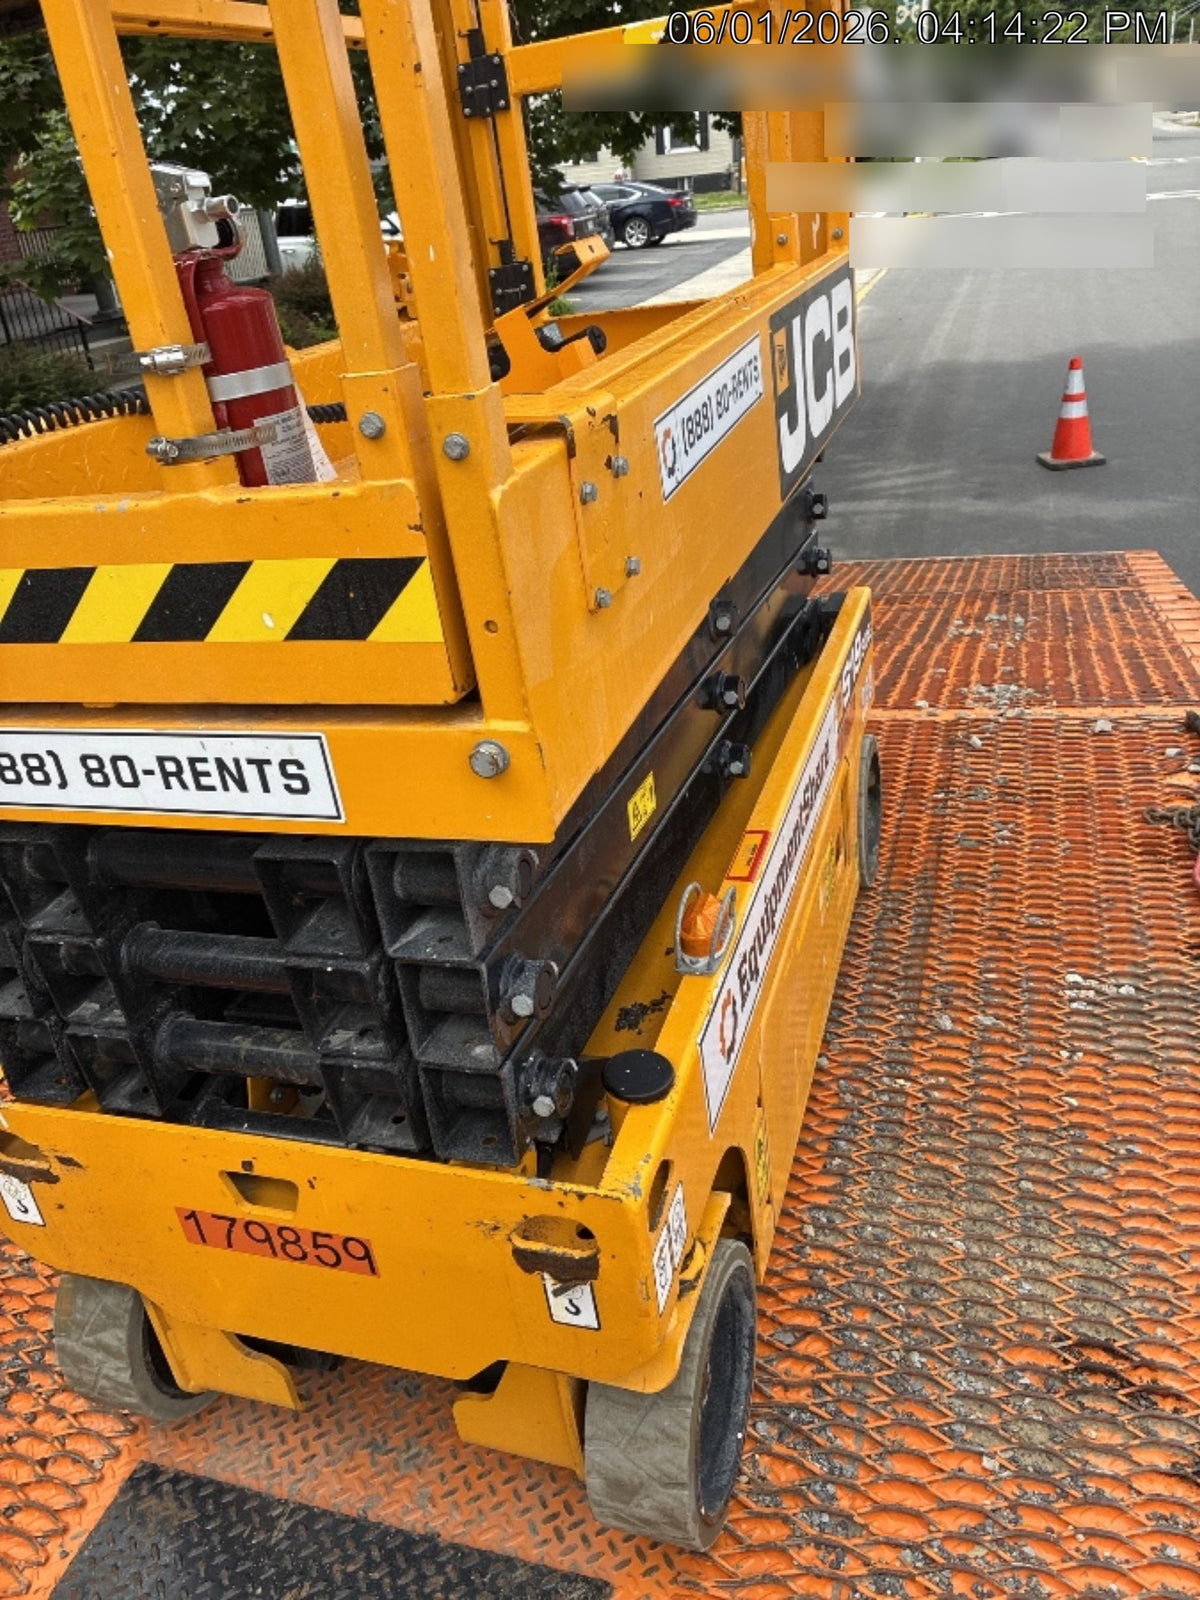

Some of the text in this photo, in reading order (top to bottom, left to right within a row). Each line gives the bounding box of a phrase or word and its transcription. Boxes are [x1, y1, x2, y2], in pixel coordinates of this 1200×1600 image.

[682, 355, 760, 456] (888) 80-RENTS
[780, 278, 855, 473] JCB
[79, 754, 310, 795] 80-RENTS
[184, 1210, 378, 1275] 179859
